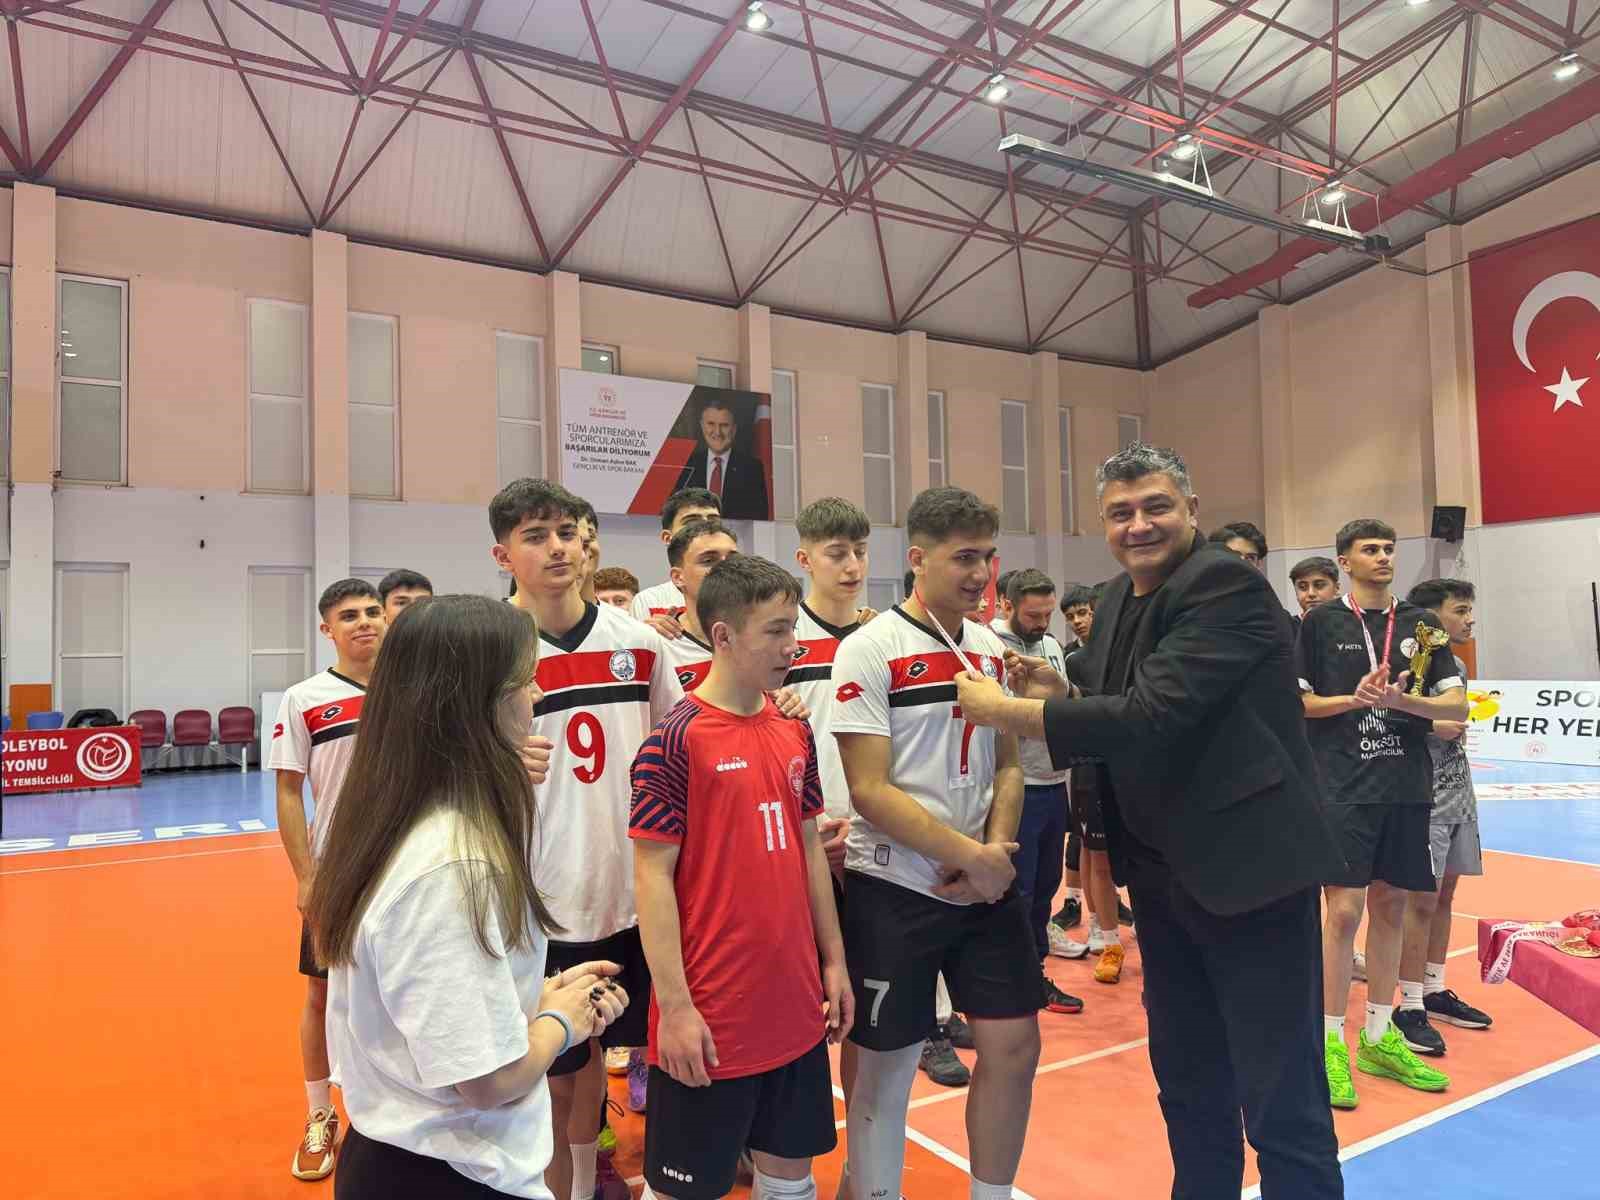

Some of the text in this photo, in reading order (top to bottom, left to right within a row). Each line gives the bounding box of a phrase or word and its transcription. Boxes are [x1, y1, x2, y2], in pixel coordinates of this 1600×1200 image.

[566, 423, 648, 439] TÜM ANTRENÖR VE
[565, 443, 608, 454] BAŞARILAR
[569, 433, 647, 448] SPORCULARIMIZA
[1536, 690, 1600, 708] SPO
[1493, 716, 1549, 735] HER
[566, 712, 607, 784] 9
[2, 758, 48, 773] YONU
[13, 773, 73, 787] TEMSİLCİLİĞİ
[758, 801, 787, 852] 11
[863, 978, 890, 1027] 7
